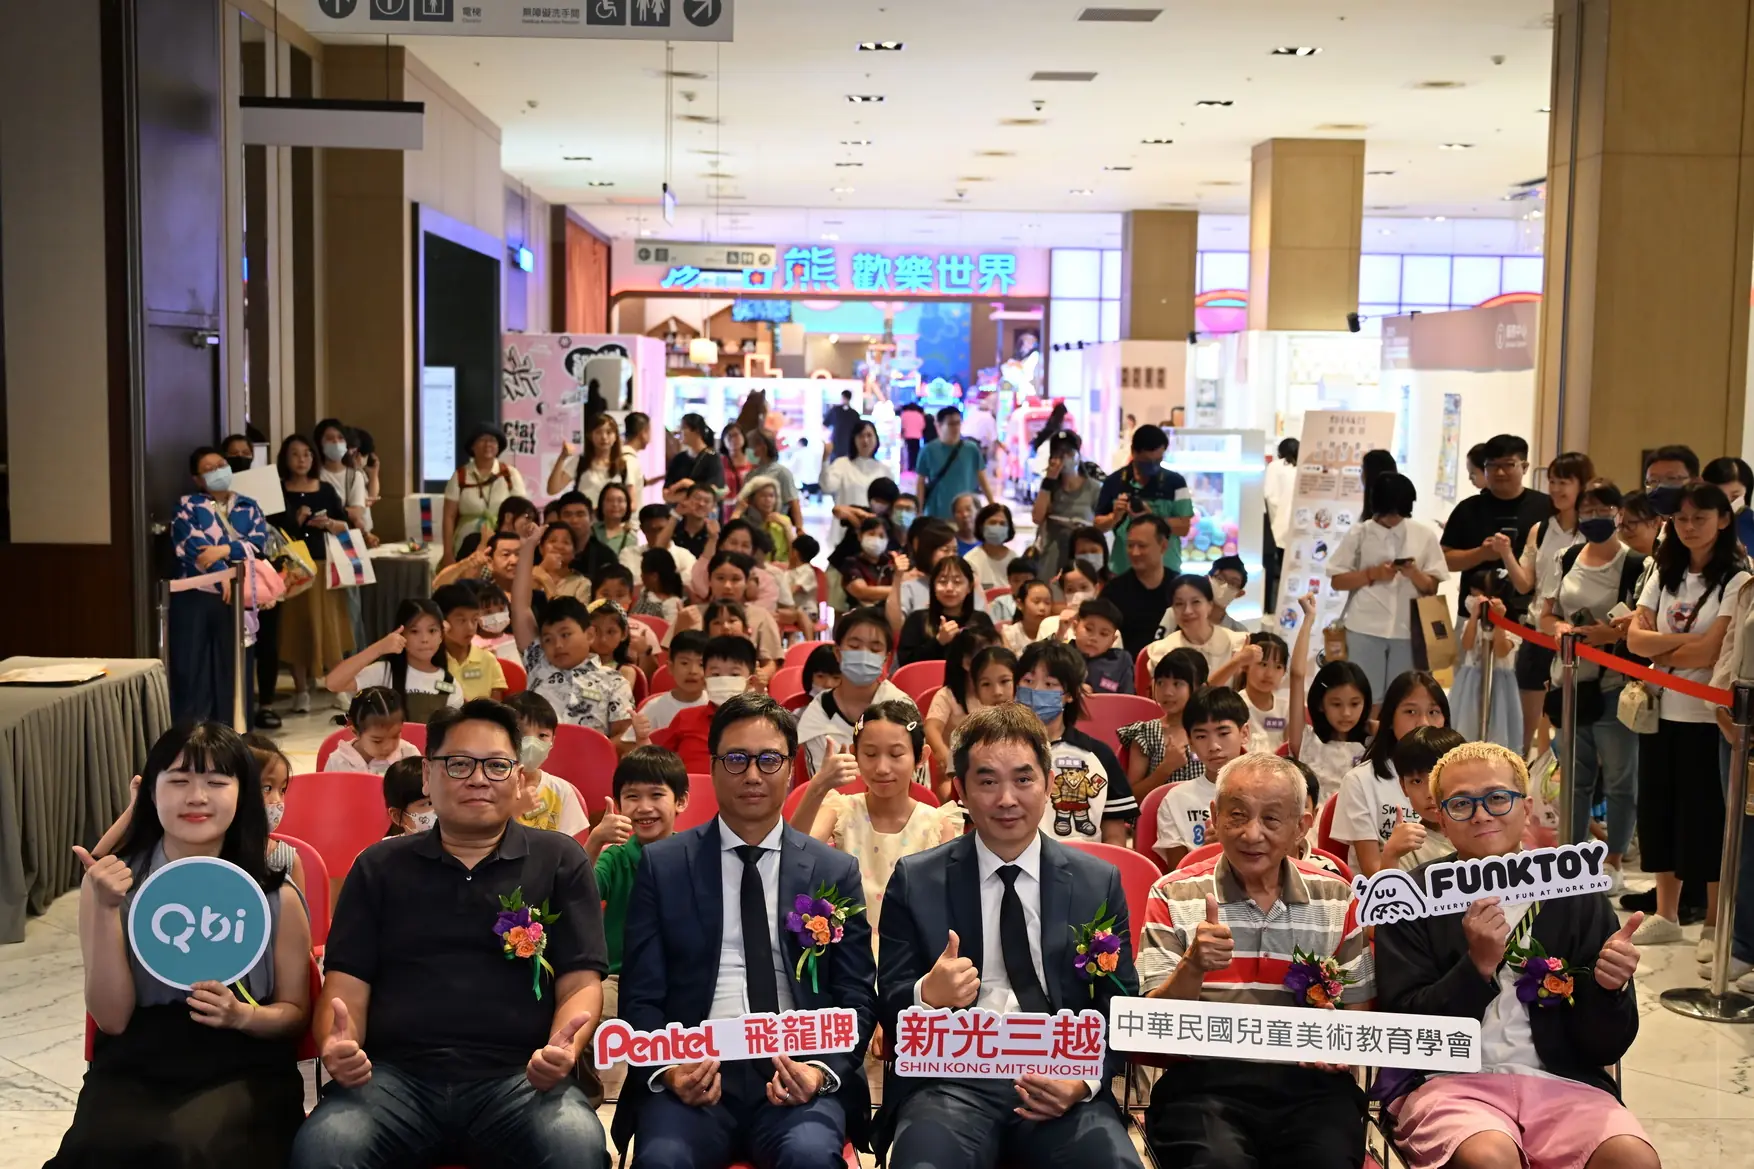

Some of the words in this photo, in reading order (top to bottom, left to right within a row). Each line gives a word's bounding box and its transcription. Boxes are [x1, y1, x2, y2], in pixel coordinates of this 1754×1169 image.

[852, 252, 1017, 295] 歡樂世界
[1187, 809, 1210, 822] IT'S
[1429, 845, 1604, 899] FUNKTOY
[1434, 901, 1472, 912] EVERYD
[1515, 891, 1535, 900] FUN
[1540, 889, 1551, 897] AT
[1557, 884, 1585, 894] WORK
[1590, 880, 1609, 889] DAY
[151, 903, 246, 954] Qbi
[598, 1024, 720, 1065] Pentel
[744, 1013, 855, 1055] 飛龍牌
[900, 1012, 1102, 1061] 新光三越
[1116, 1009, 1473, 1059] 中華民國兒童美術教育學會
[900, 1061, 940, 1073] SHIN
[943, 1062, 991, 1074] KONG
[995, 1063, 1099, 1076] MITSUKOSHI
